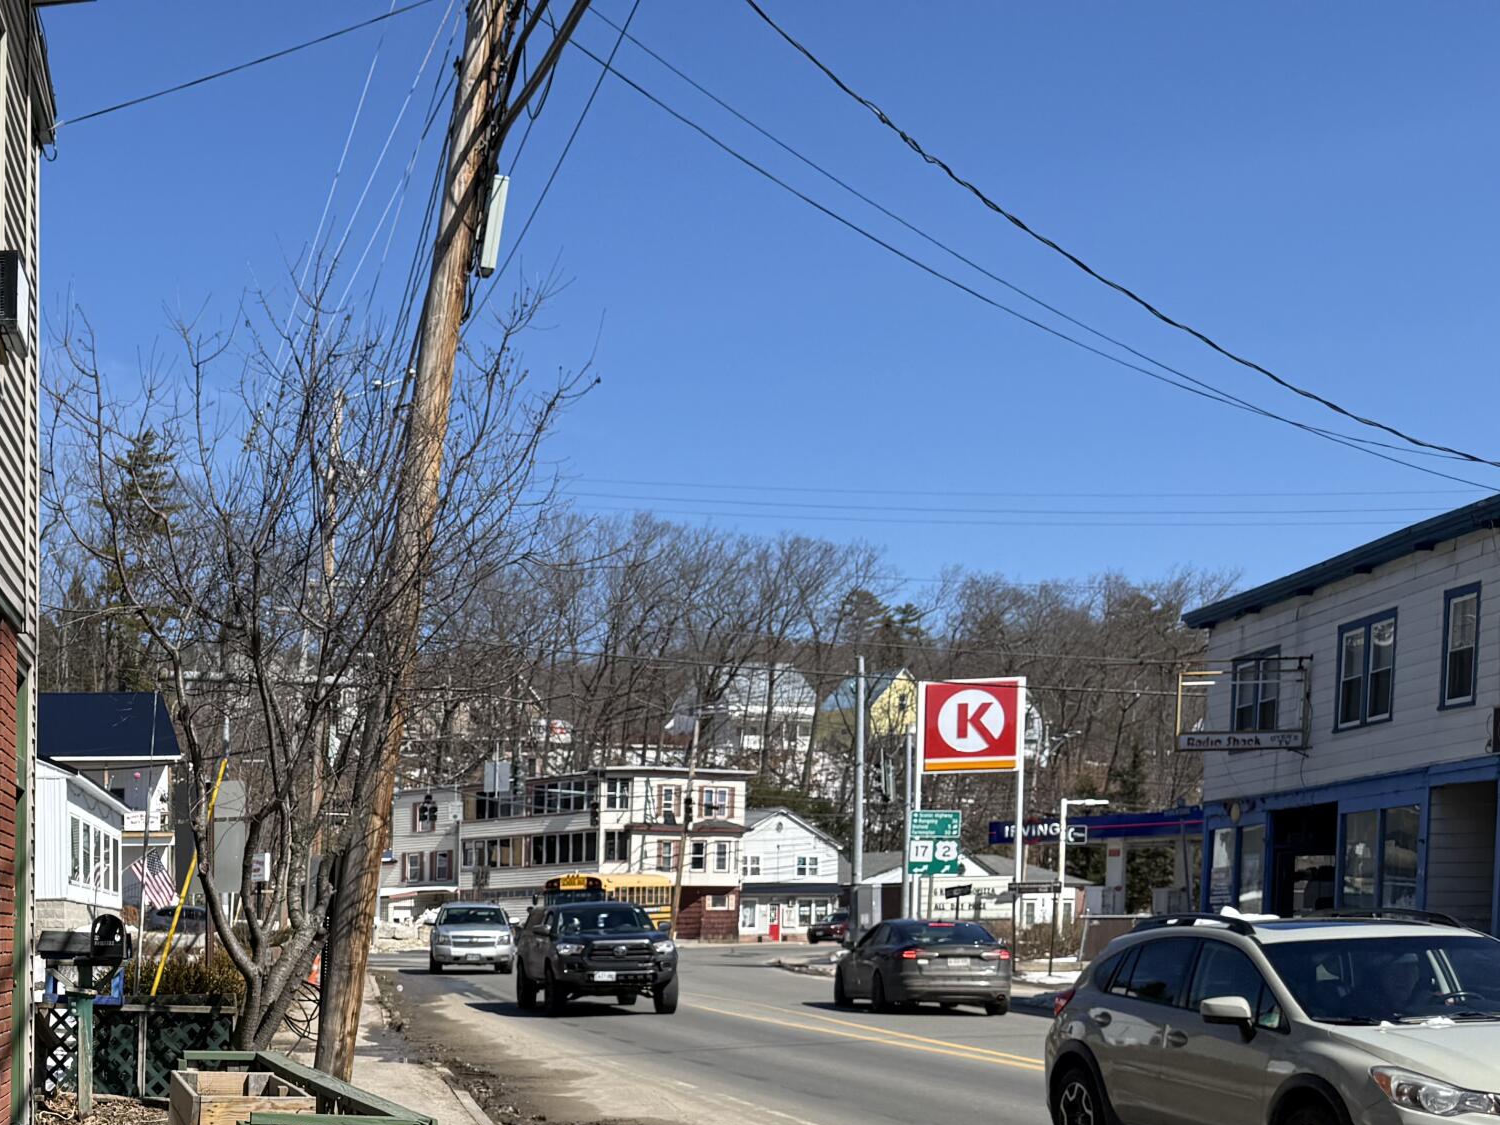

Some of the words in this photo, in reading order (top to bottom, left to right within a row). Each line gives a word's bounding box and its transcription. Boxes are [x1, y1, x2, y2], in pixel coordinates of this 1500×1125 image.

[956, 701, 999, 747] K
[1186, 737, 1222, 747] Radio
[915, 845, 929, 857] 17
[941, 845, 951, 857] 2
